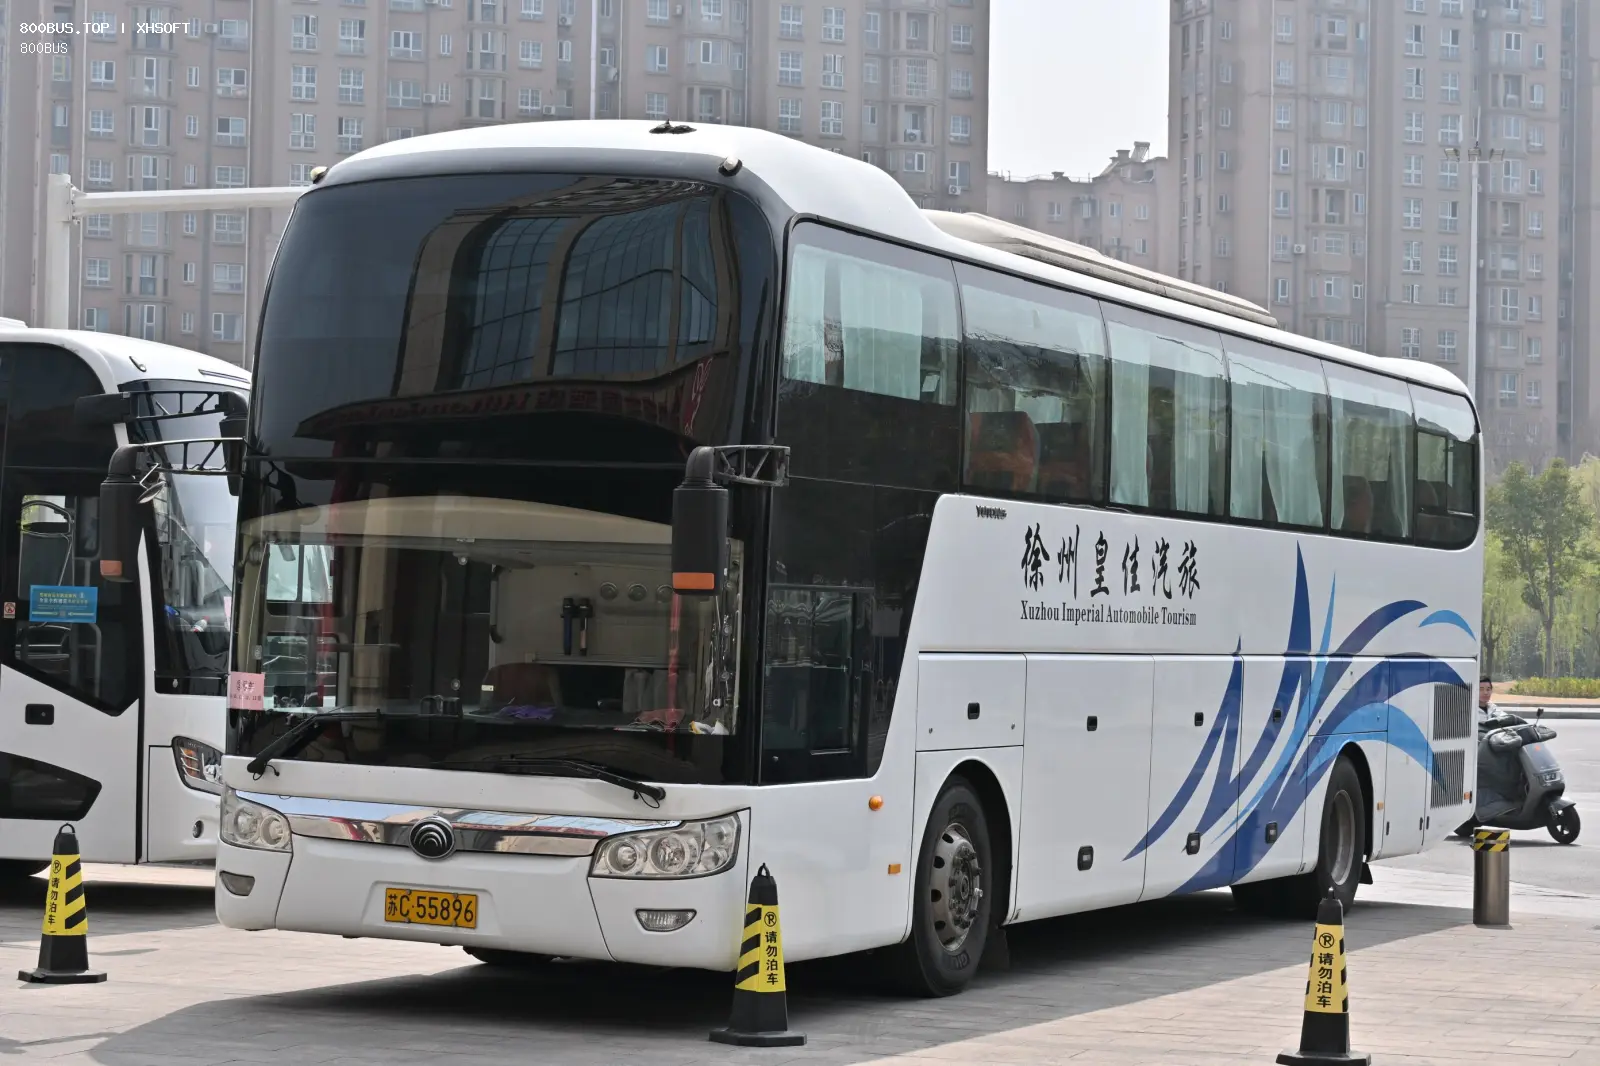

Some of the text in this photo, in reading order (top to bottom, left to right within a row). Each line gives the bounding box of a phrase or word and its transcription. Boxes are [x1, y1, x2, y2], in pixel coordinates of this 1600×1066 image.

[1021, 600, 1197, 625] Xuzhou Imperial Automobile Tourism
[48, 877, 60, 925] 请勿泊车
[765, 930, 779, 985] 请勿泊车
[1315, 952, 1334, 1008] 请勿泊车
